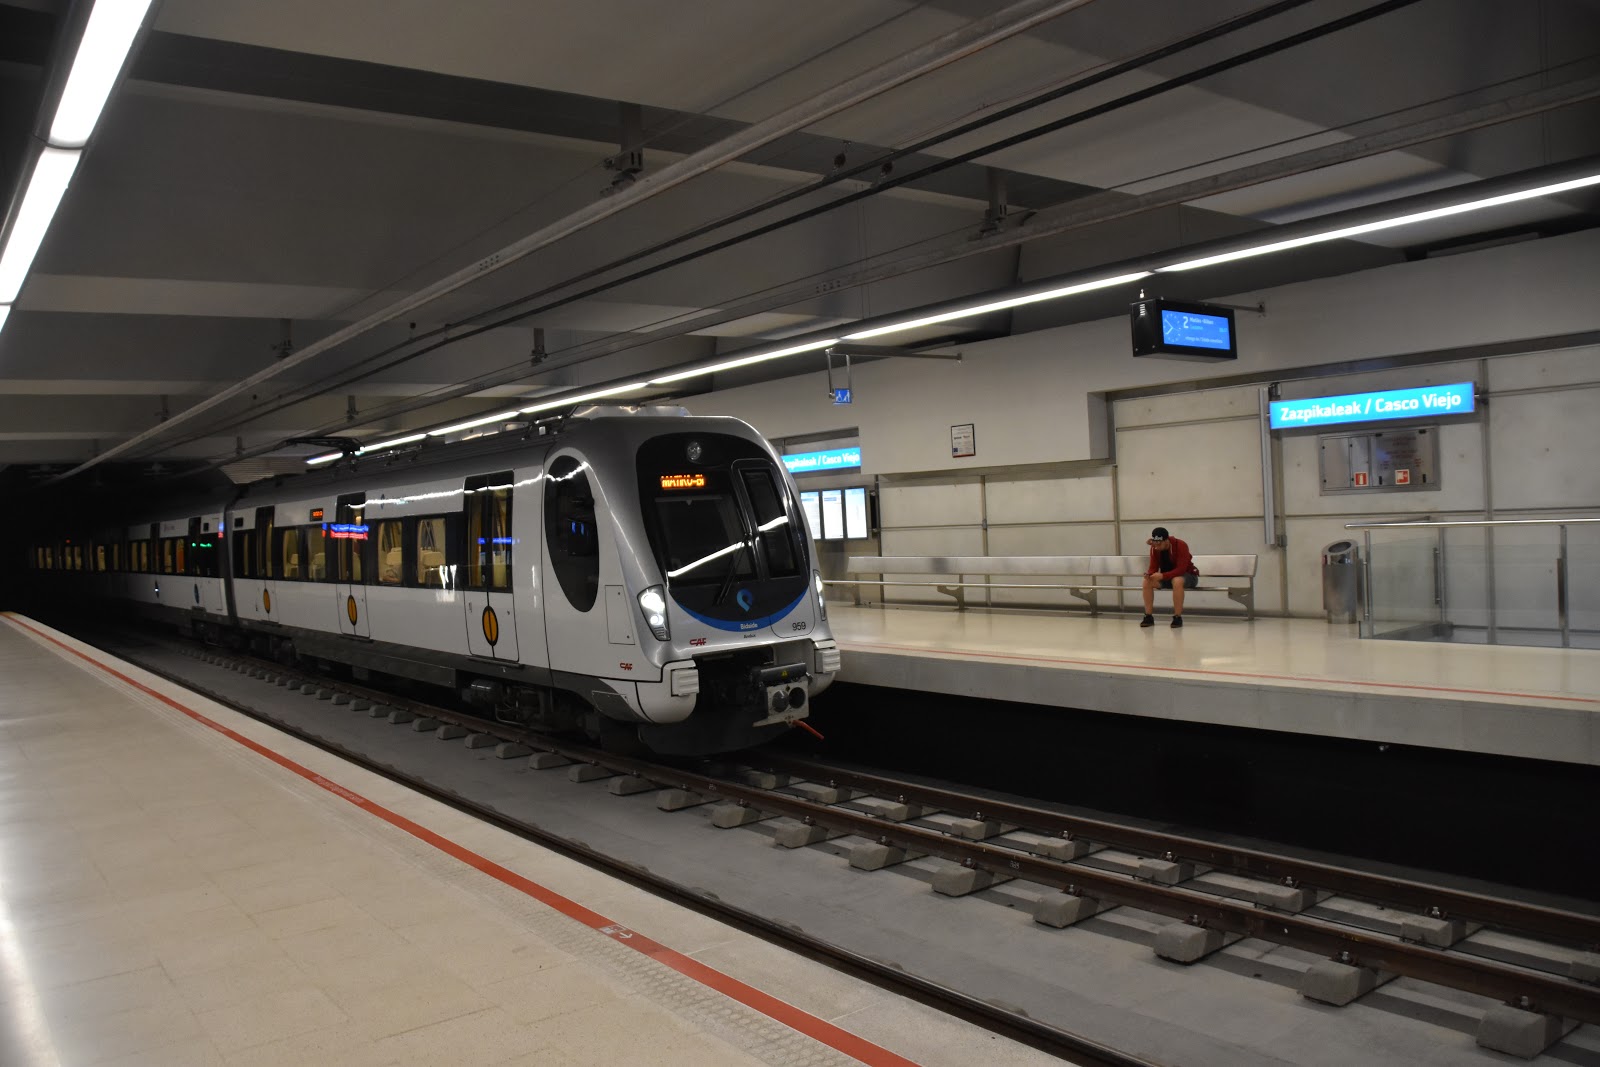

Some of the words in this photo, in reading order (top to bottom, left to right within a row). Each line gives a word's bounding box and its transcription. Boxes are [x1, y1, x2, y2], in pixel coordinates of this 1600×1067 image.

[1281, 402, 1361, 422] Zazpikaleak
[1364, 398, 1371, 415] /
[1375, 398, 1418, 412] Casco
[1422, 393, 1461, 409] Viejo
[823, 455, 841, 464] Casco
[843, 453, 859, 463] Viejo
[792, 621, 807, 631] 959
[689, 637, 707, 647] CAF
